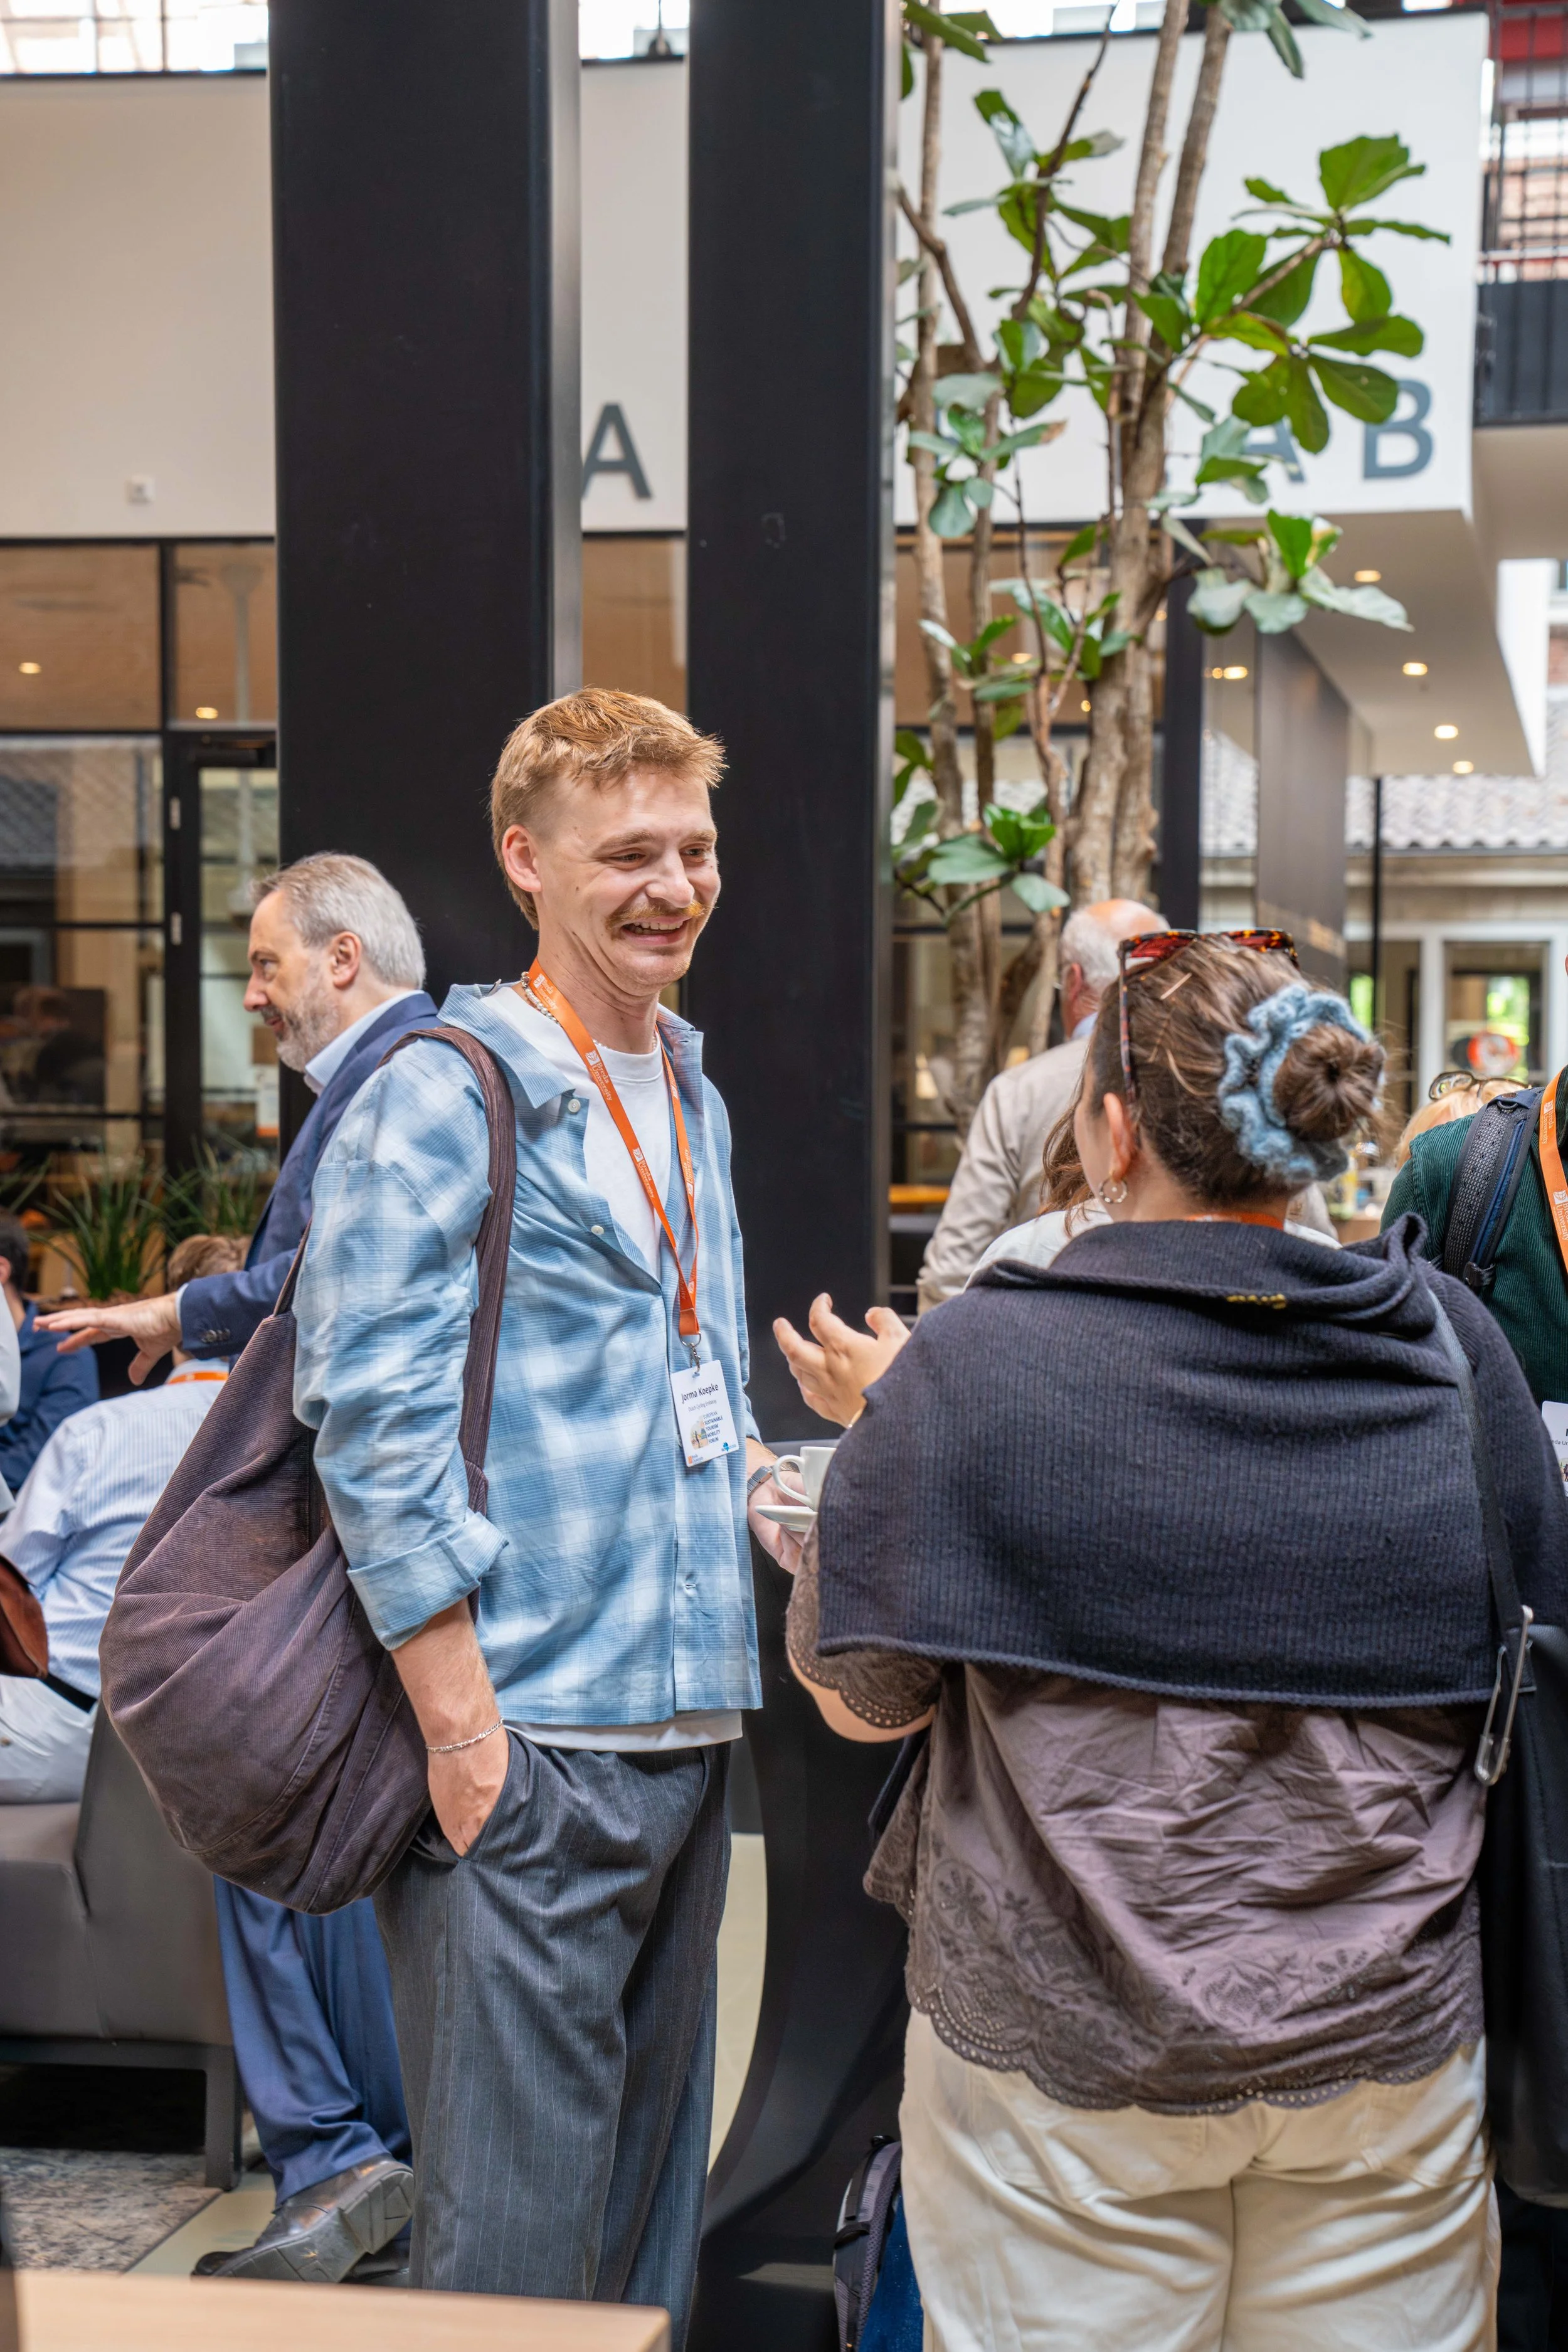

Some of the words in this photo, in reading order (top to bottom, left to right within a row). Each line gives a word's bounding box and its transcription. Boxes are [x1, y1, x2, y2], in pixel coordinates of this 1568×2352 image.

[581, 403, 652, 499] A
[591, 1066, 613, 1101] University
[596, 1061, 609, 1084] Breda
[638, 1162, 655, 1199] University
[641, 1159, 652, 1181] Breda
[1556, 1204, 1568, 1240] University
[681, 1391, 697, 1404] Jorma
[698, 1383, 718, 1396] Koepke
[704, 1415, 723, 1425] SUSTAINABLE
